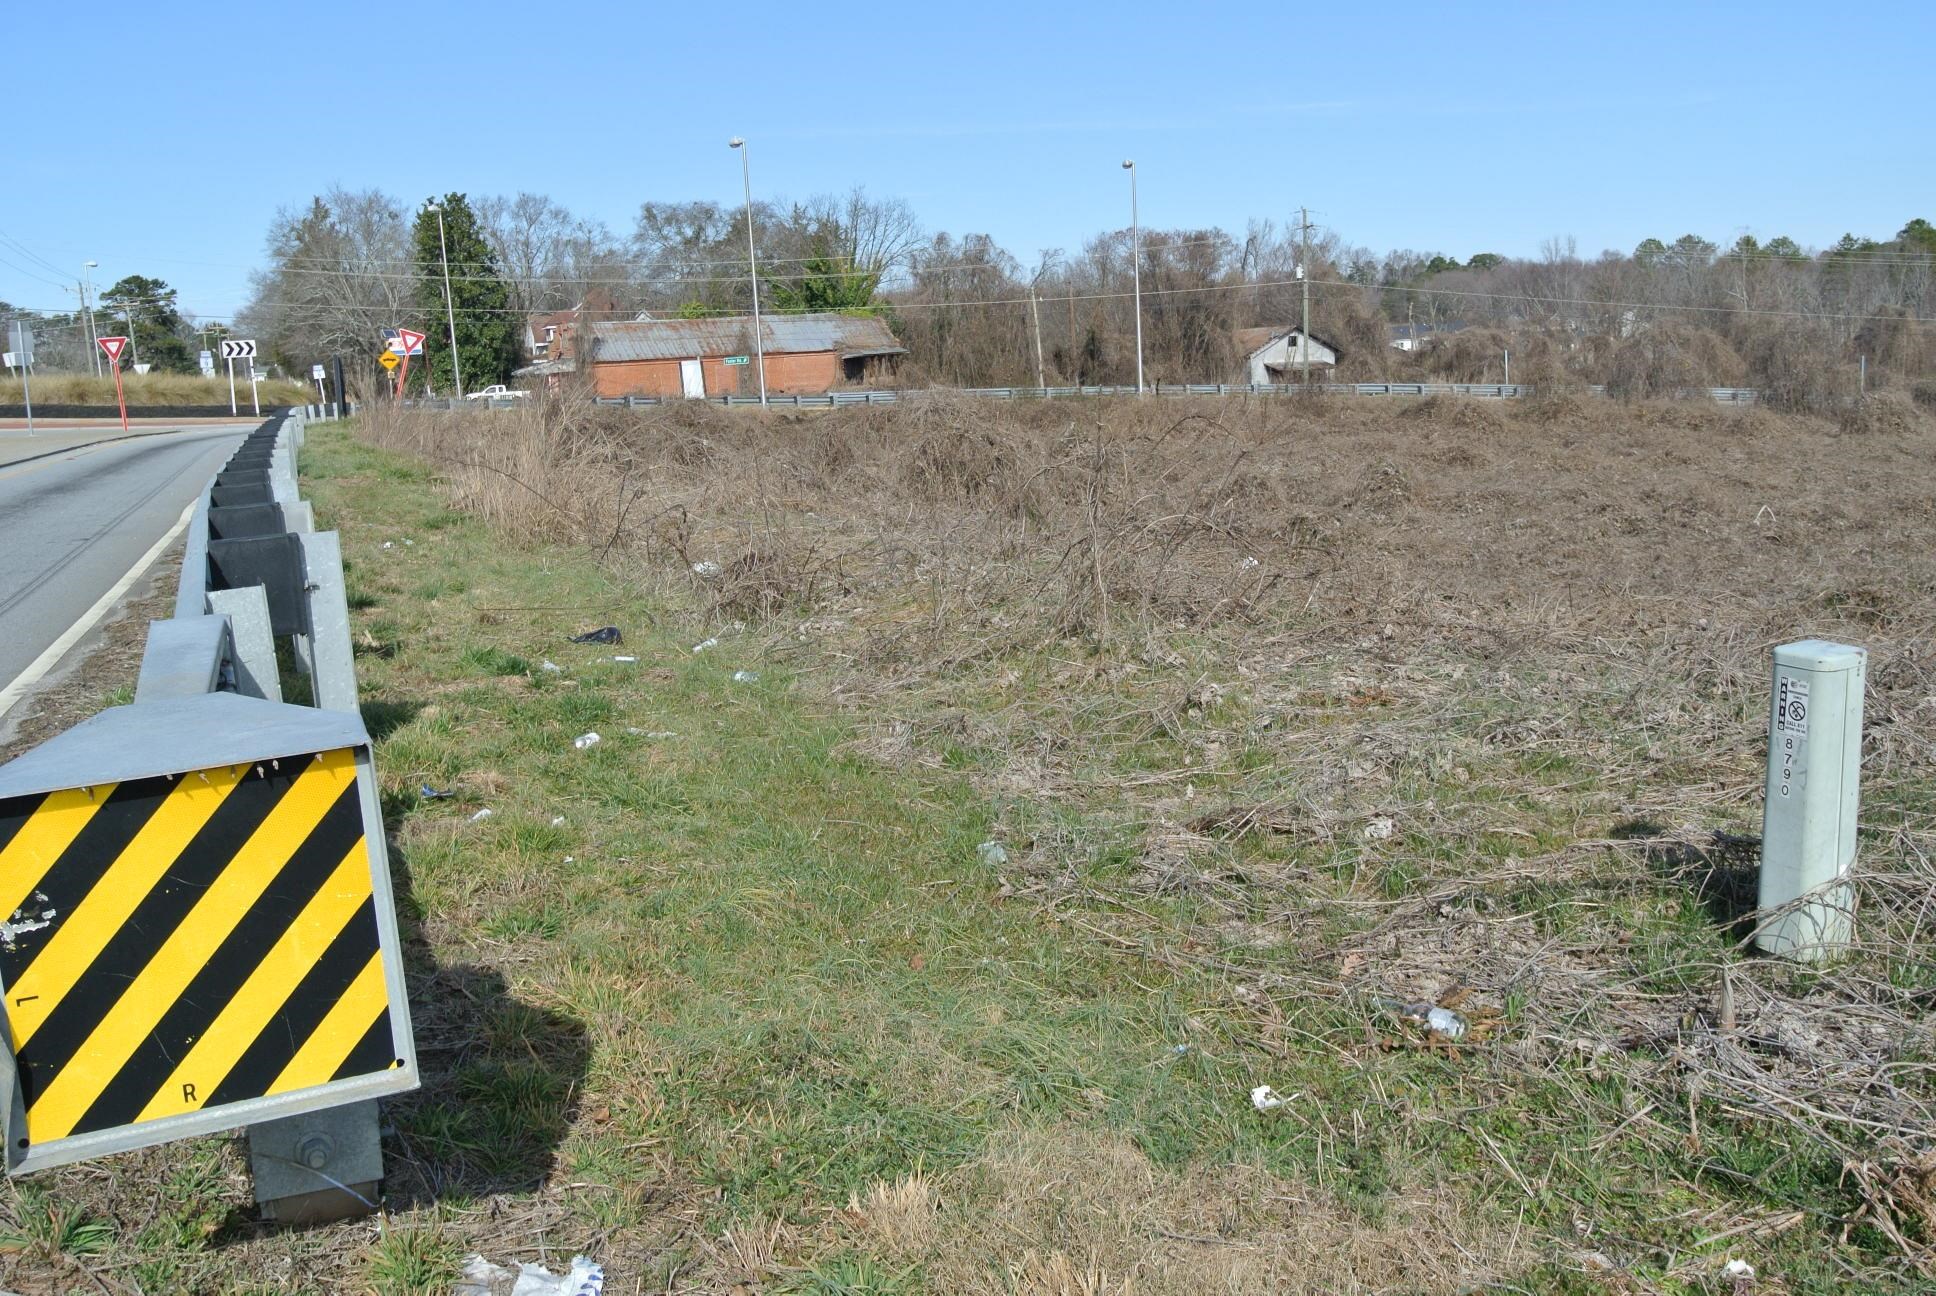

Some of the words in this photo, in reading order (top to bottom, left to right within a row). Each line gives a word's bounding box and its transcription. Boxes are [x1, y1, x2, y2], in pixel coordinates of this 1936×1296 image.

[1778, 677, 1788, 730] WARNING
[1782, 738, 1793, 796] 8790
[182, 1083, 197, 1103] R
